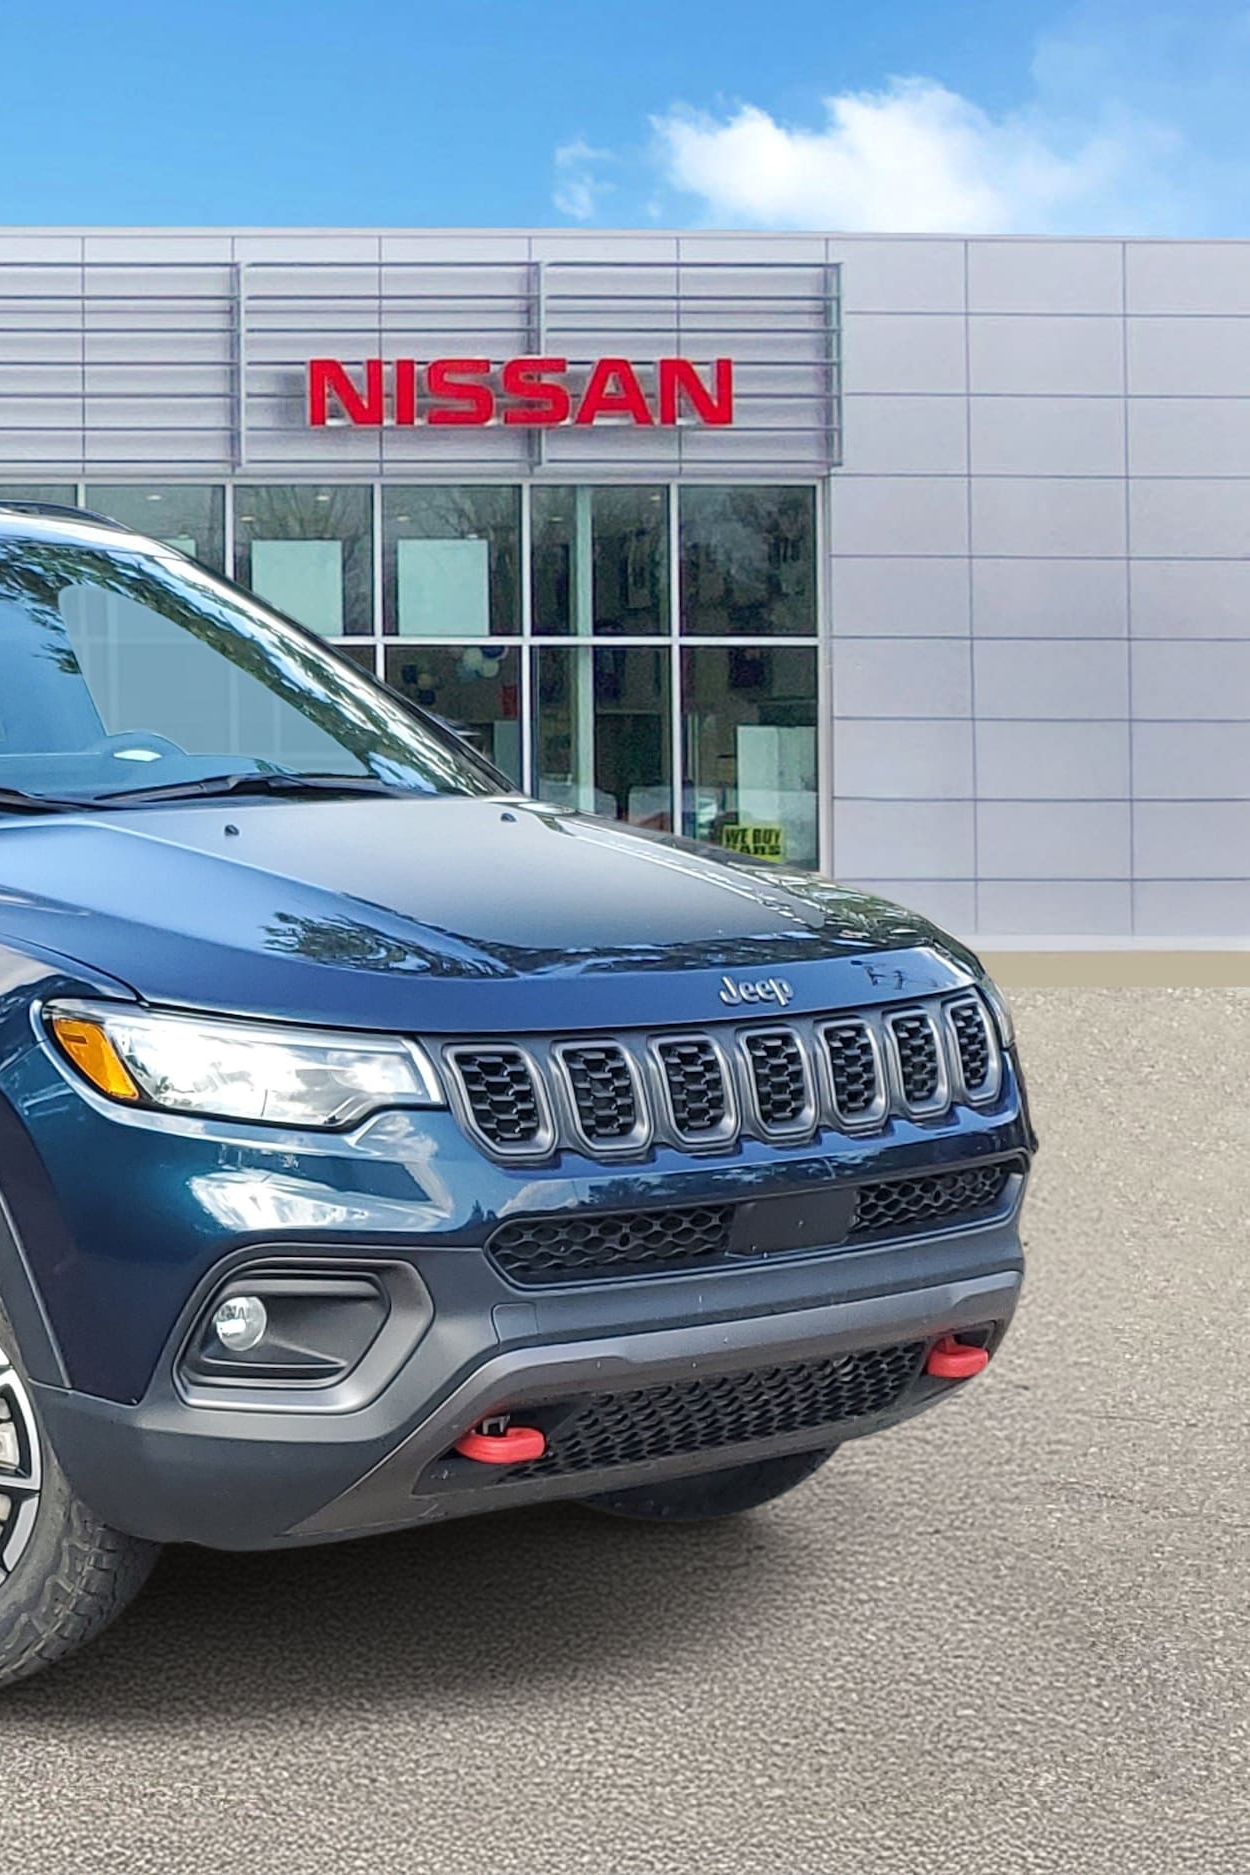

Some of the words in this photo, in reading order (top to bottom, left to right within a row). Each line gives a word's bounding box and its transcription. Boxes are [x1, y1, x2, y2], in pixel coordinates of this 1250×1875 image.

[307, 357, 734, 428] NISSAN
[725, 827, 749, 845] WE
[752, 828, 782, 845] BUY
[719, 975, 794, 1008] Jeep
